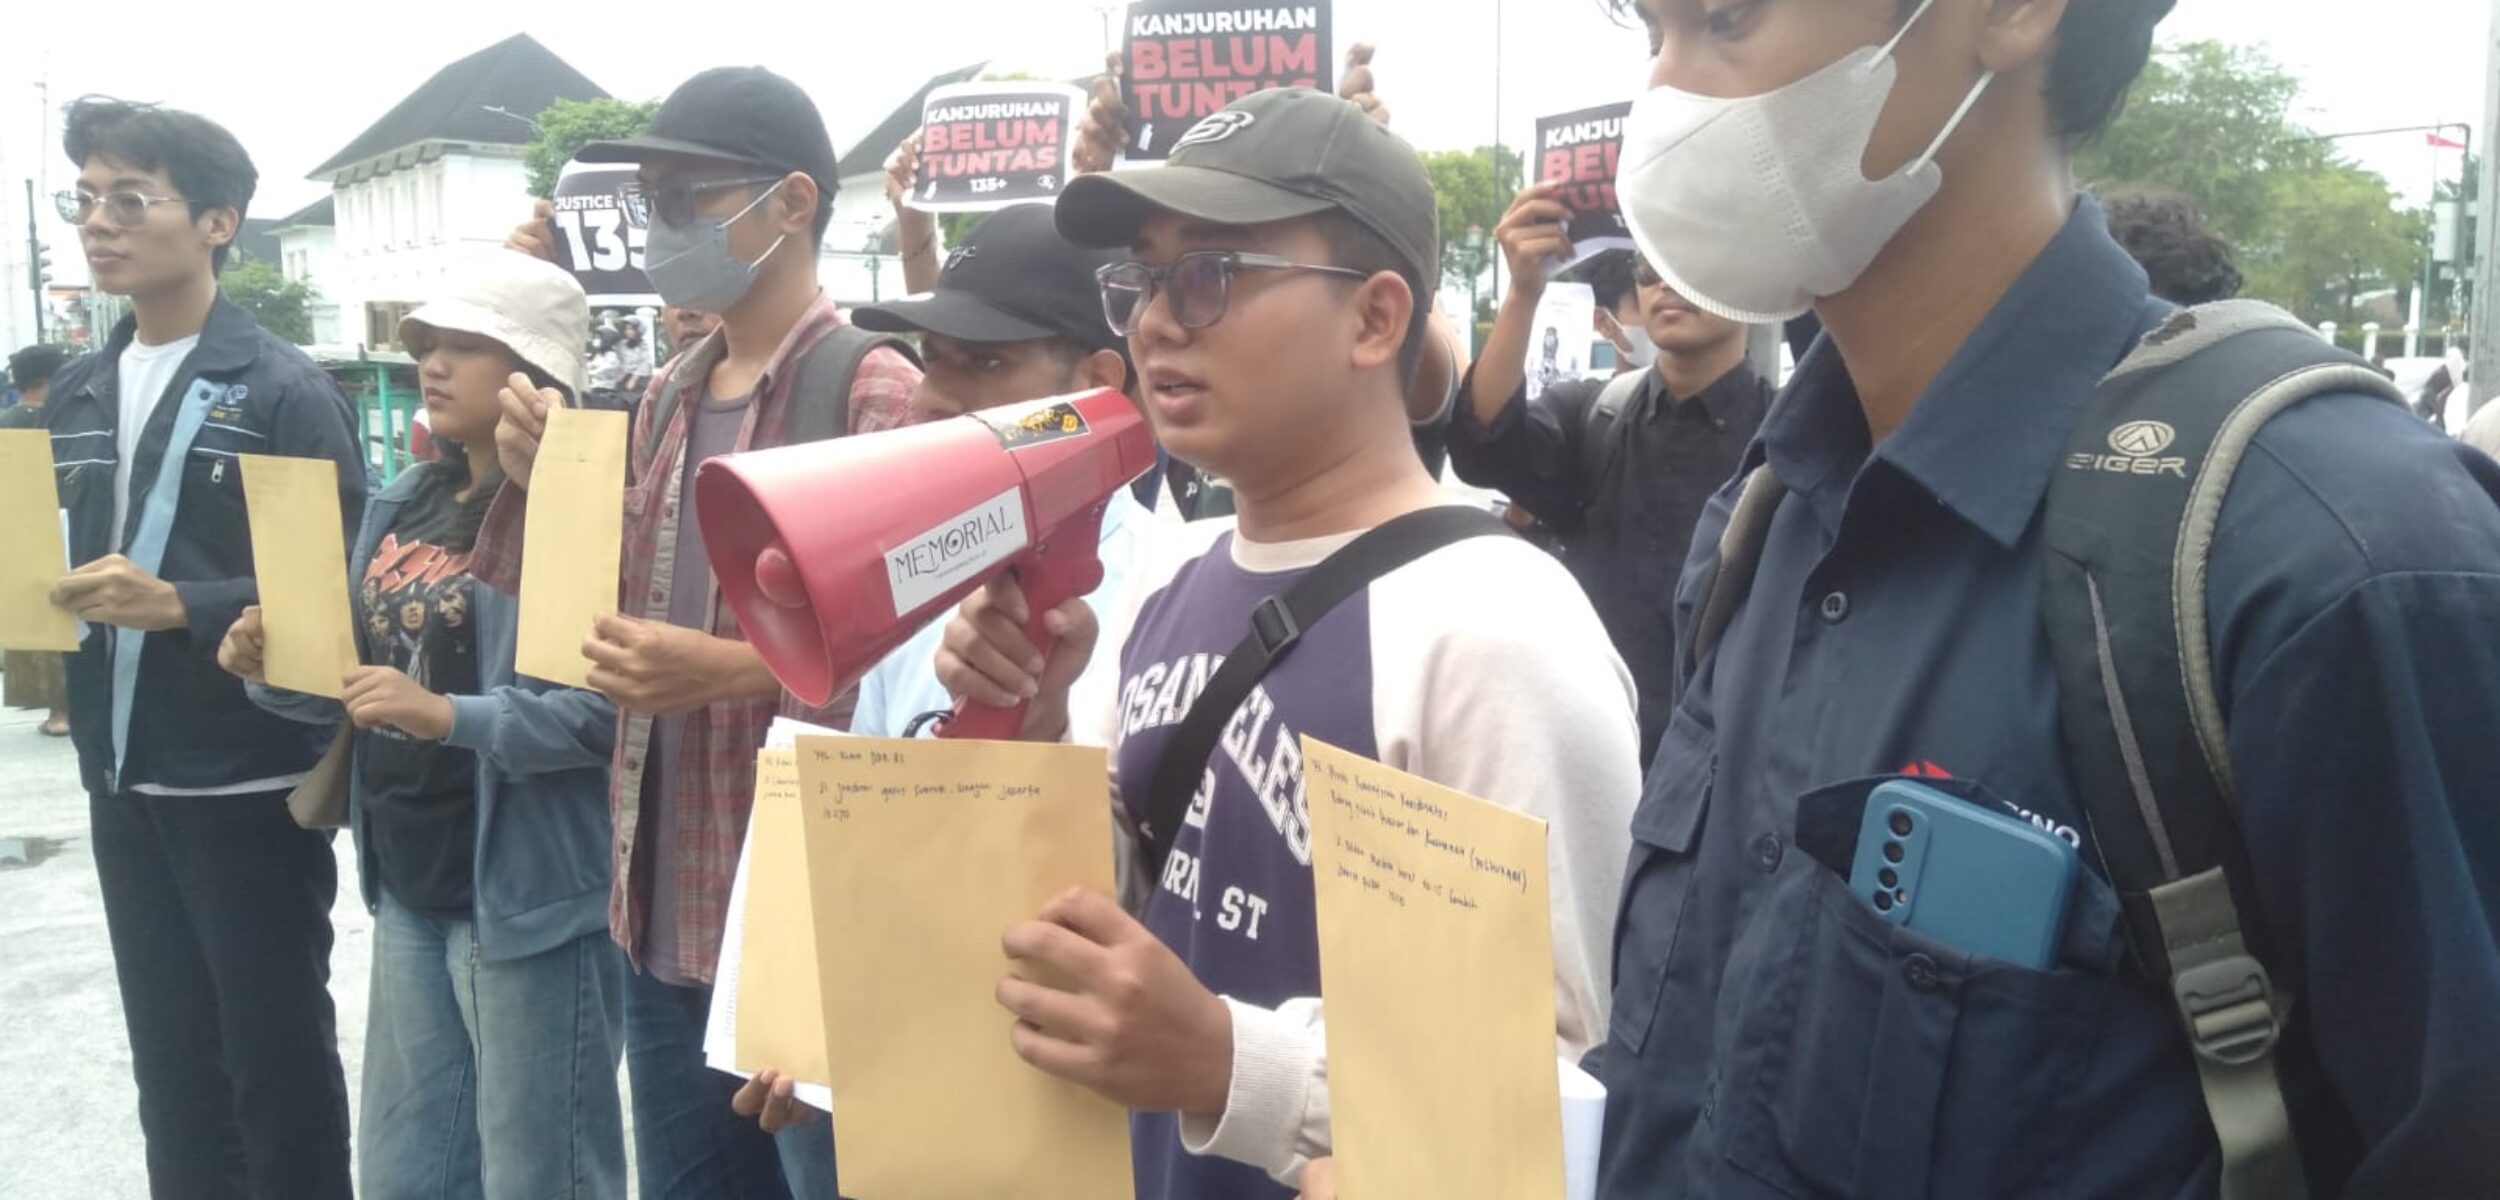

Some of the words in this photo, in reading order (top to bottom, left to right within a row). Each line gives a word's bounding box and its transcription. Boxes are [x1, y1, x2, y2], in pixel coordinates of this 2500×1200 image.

[1132, 7, 1317, 36] KANJURUHAN
[1131, 33, 1317, 80] BELUM
[926, 102, 1060, 124] KANJURUHAN
[924, 118, 1059, 153] BELUM
[923, 146, 1058, 178] TUNTAS
[970, 178, 1008, 193] 135+
[555, 195, 614, 210] JUSTICE
[894, 506, 1014, 584] MEMORIAL
[1217, 886, 1268, 940] ST
